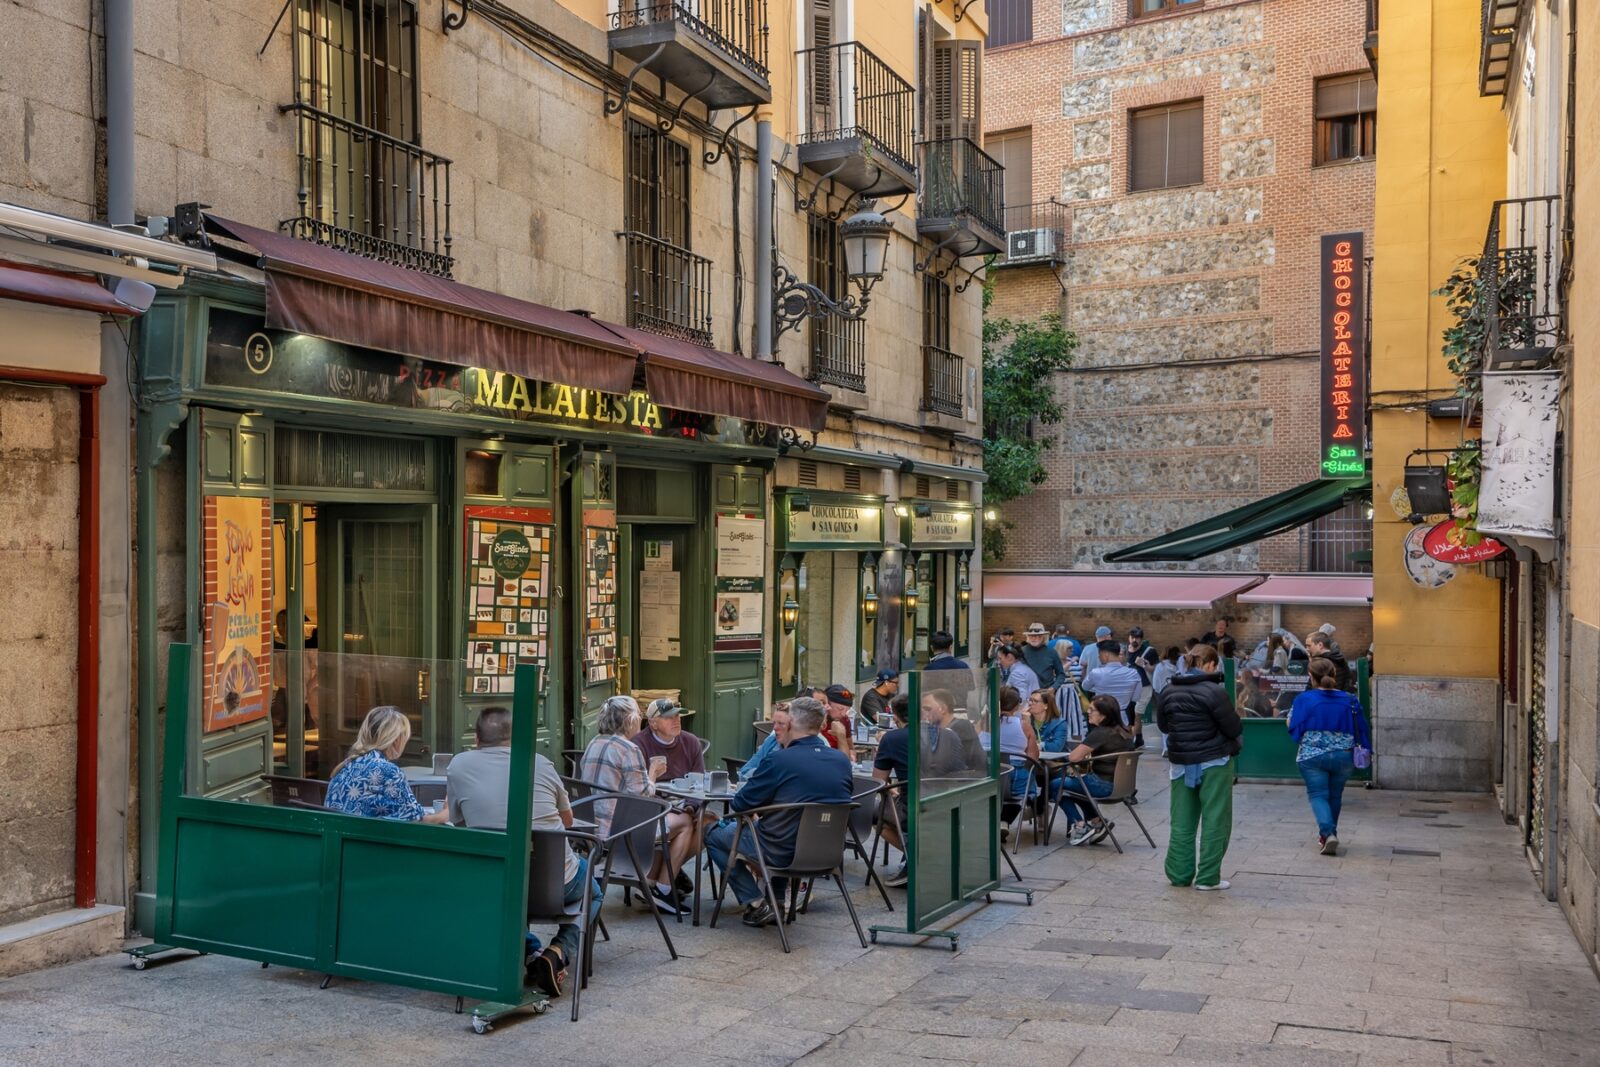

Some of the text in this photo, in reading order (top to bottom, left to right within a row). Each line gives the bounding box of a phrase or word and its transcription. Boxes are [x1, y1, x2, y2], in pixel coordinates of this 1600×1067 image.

[1332, 241, 1352, 438] CHOCOLATERIA
[254, 344, 264, 363] 5
[473, 367, 663, 429] MALATESTA
[1330, 447, 1356, 459] San
[1323, 460, 1363, 473] Ginés
[818, 521, 833, 532] SAN
